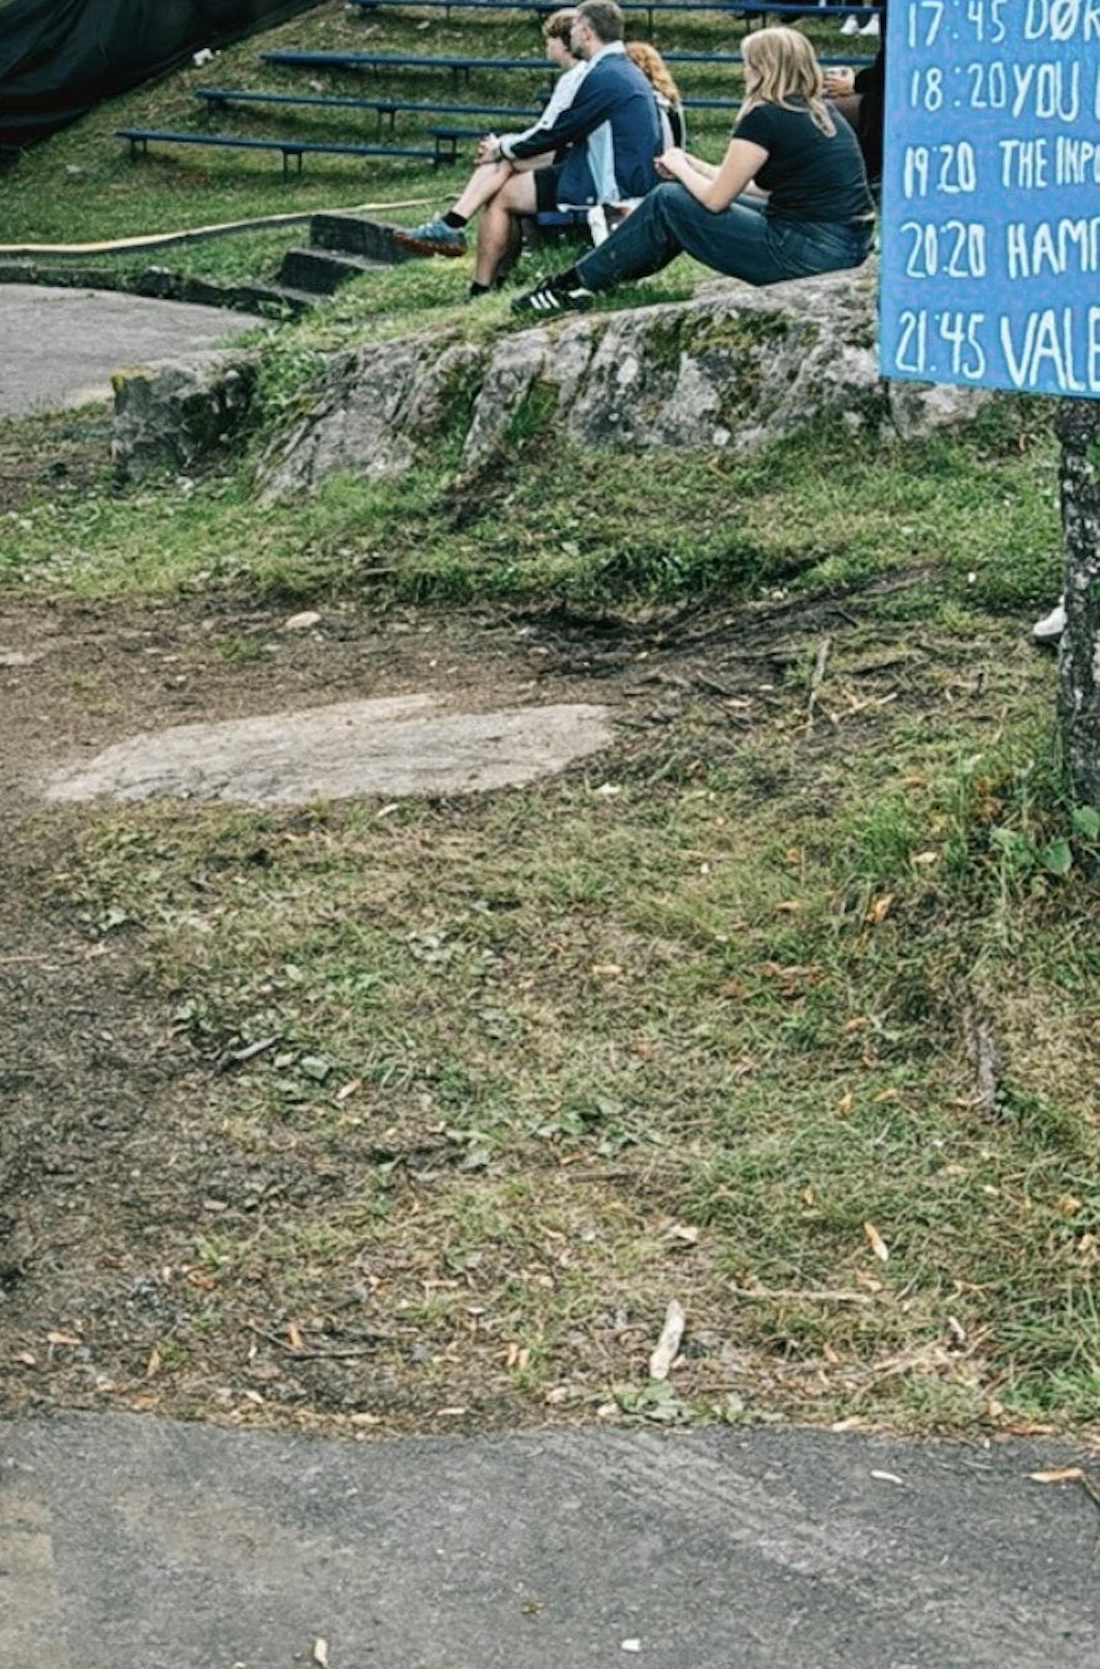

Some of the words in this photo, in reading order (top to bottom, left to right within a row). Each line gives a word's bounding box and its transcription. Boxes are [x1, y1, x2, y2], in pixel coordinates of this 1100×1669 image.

[911, 62, 1006, 112] 18:20
[1012, 61, 1080, 122] YOU
[904, 141, 976, 199] 19:20
[998, 138, 1048, 188] THE
[900, 220, 986, 278] 20:20
[895, 309, 986, 379] 21:45
